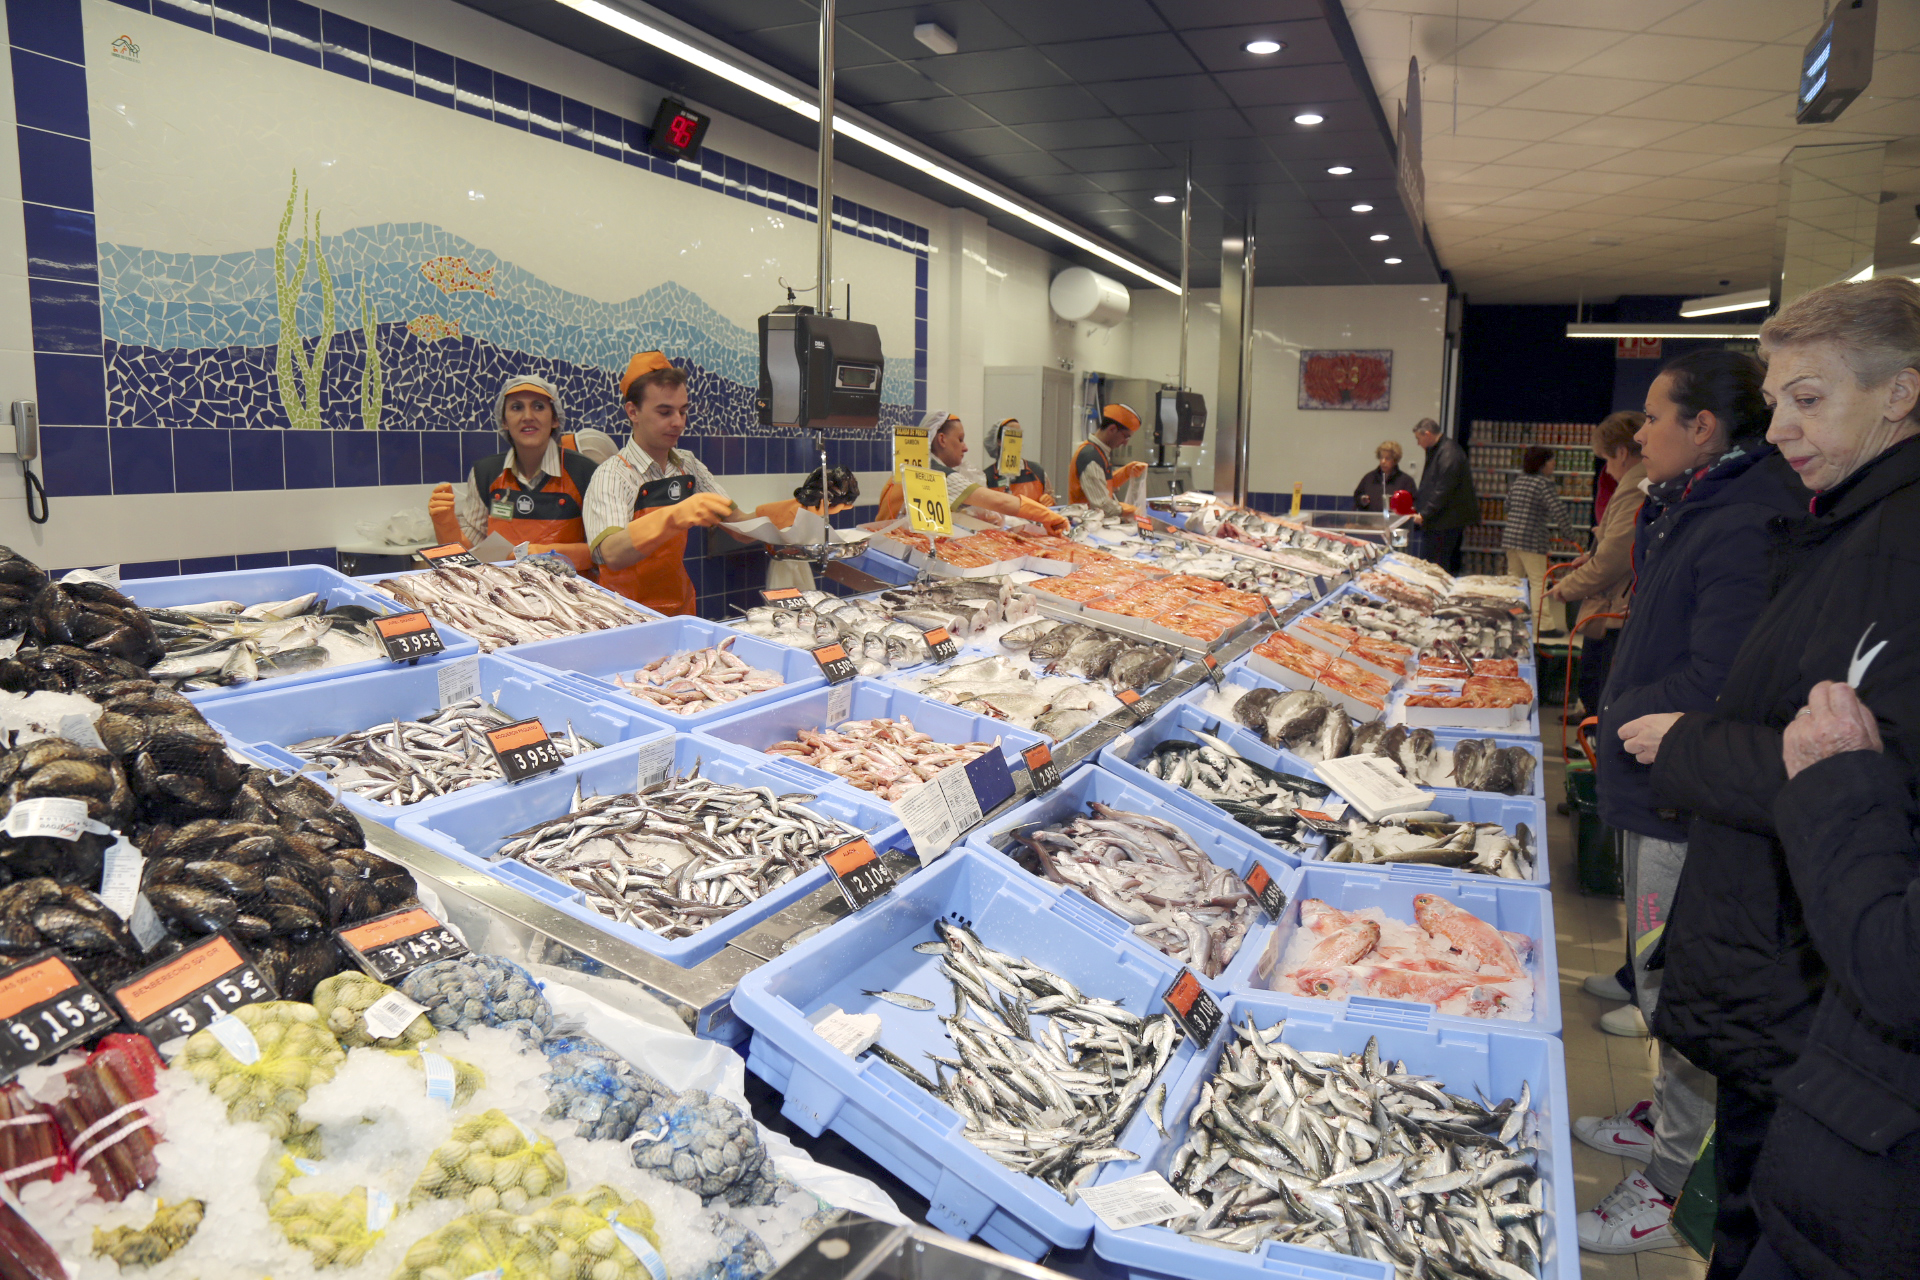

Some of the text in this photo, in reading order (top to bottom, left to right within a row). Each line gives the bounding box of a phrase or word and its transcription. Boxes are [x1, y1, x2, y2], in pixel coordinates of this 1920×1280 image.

[669, 115, 697, 148] 96
[915, 472, 935, 482] MERLUZA
[206, 947, 219, 957] GR
